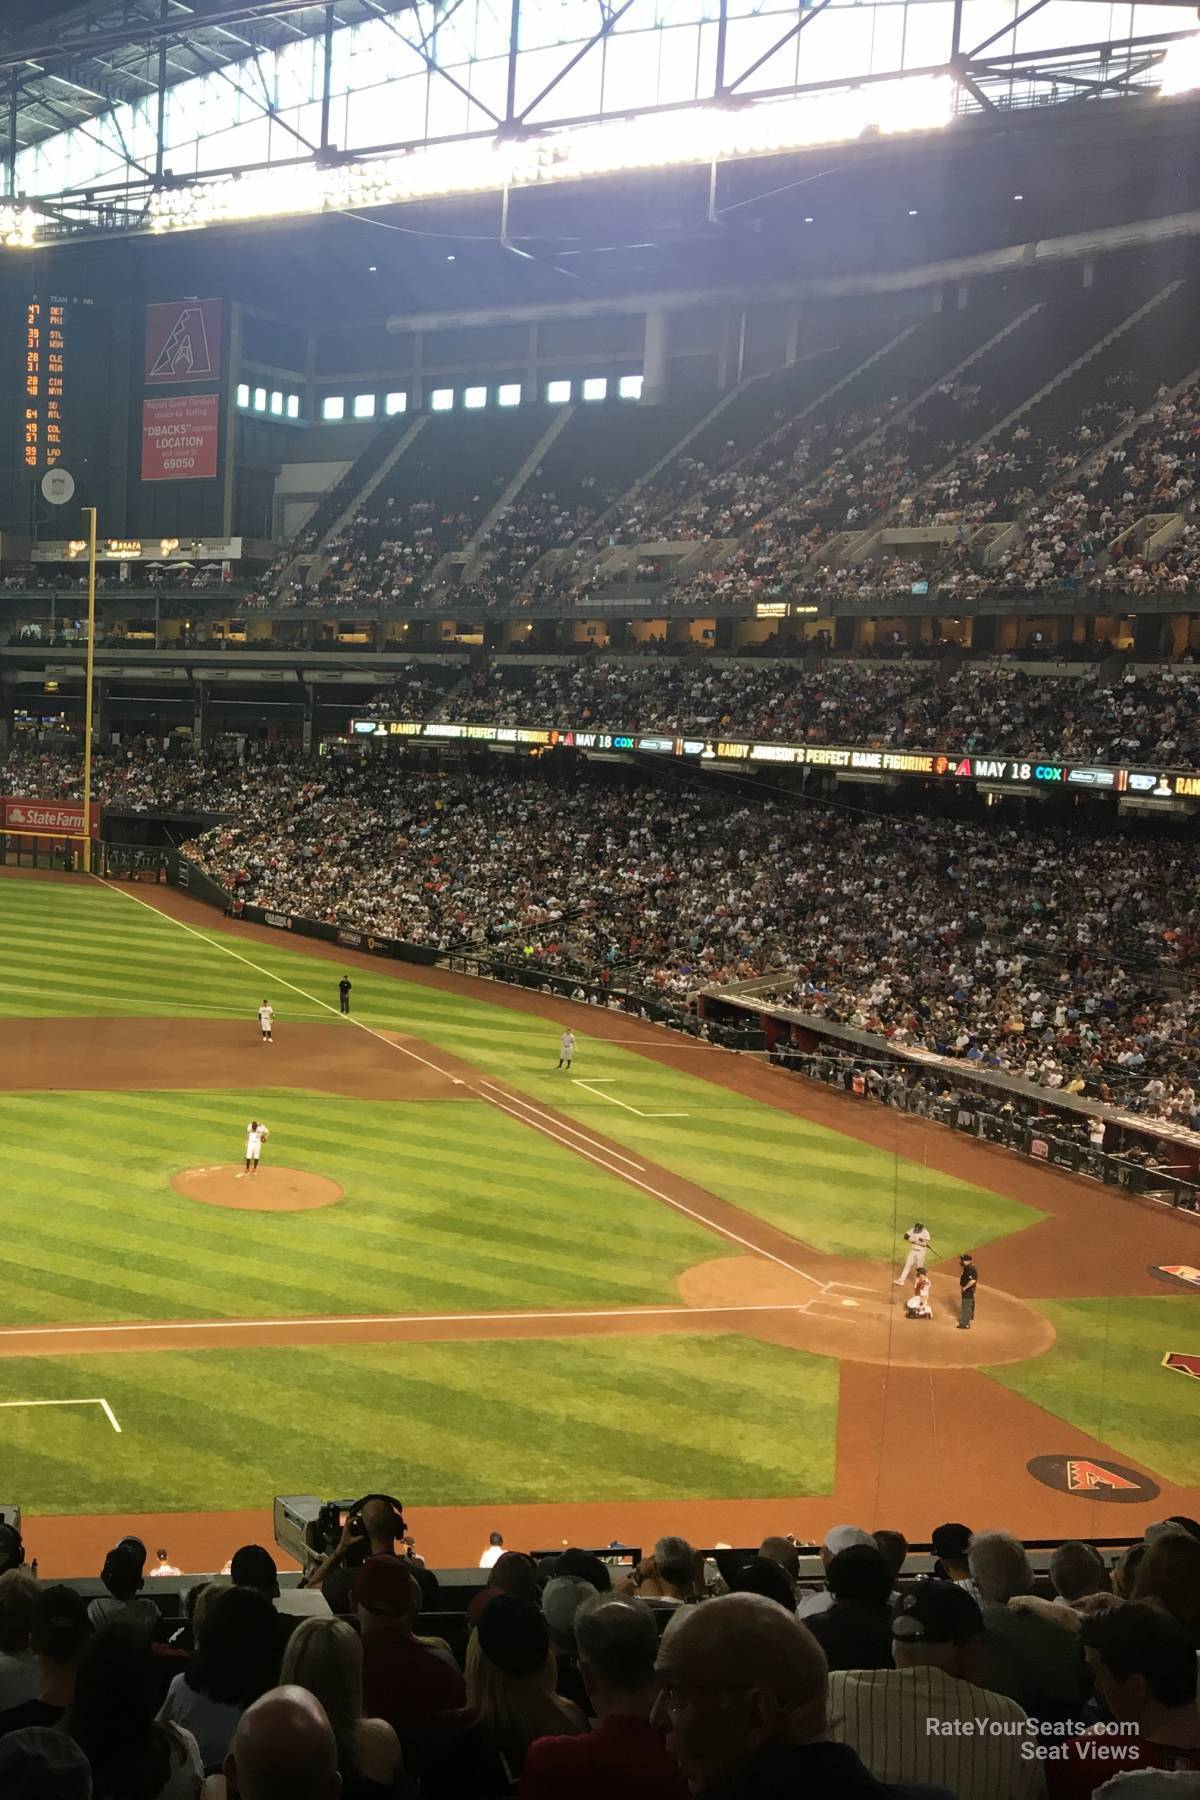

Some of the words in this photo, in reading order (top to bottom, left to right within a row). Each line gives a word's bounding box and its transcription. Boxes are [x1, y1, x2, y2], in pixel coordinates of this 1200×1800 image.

[28, 305, 40, 314] 47
[28, 315, 34, 324] 2
[28, 329, 39, 338] 39
[50, 331, 63, 339] STL
[28, 339, 38, 348] 31
[27, 363, 38, 371] 31
[26, 409, 37, 419] 64
[26, 424, 37, 433] 49
[26, 434, 37, 442] 57
[156, 436, 203, 448] LOCATION
[163, 458, 194, 469] 69050
[390, 723, 422, 735] RANDY
[576, 734, 597, 747] MAY
[599, 735, 612, 748] 18
[614, 736, 634, 749] COX
[717, 743, 749, 758] RANDY
[806, 749, 850, 766] PERFECT
[852, 752, 882, 768] GAME
[883, 754, 933, 772] FIGURINE
[975, 761, 1006, 778] MAY
[1011, 763, 1031, 780] 18
[1035, 765, 1062, 781] COX
[26, 810, 56, 825] State
